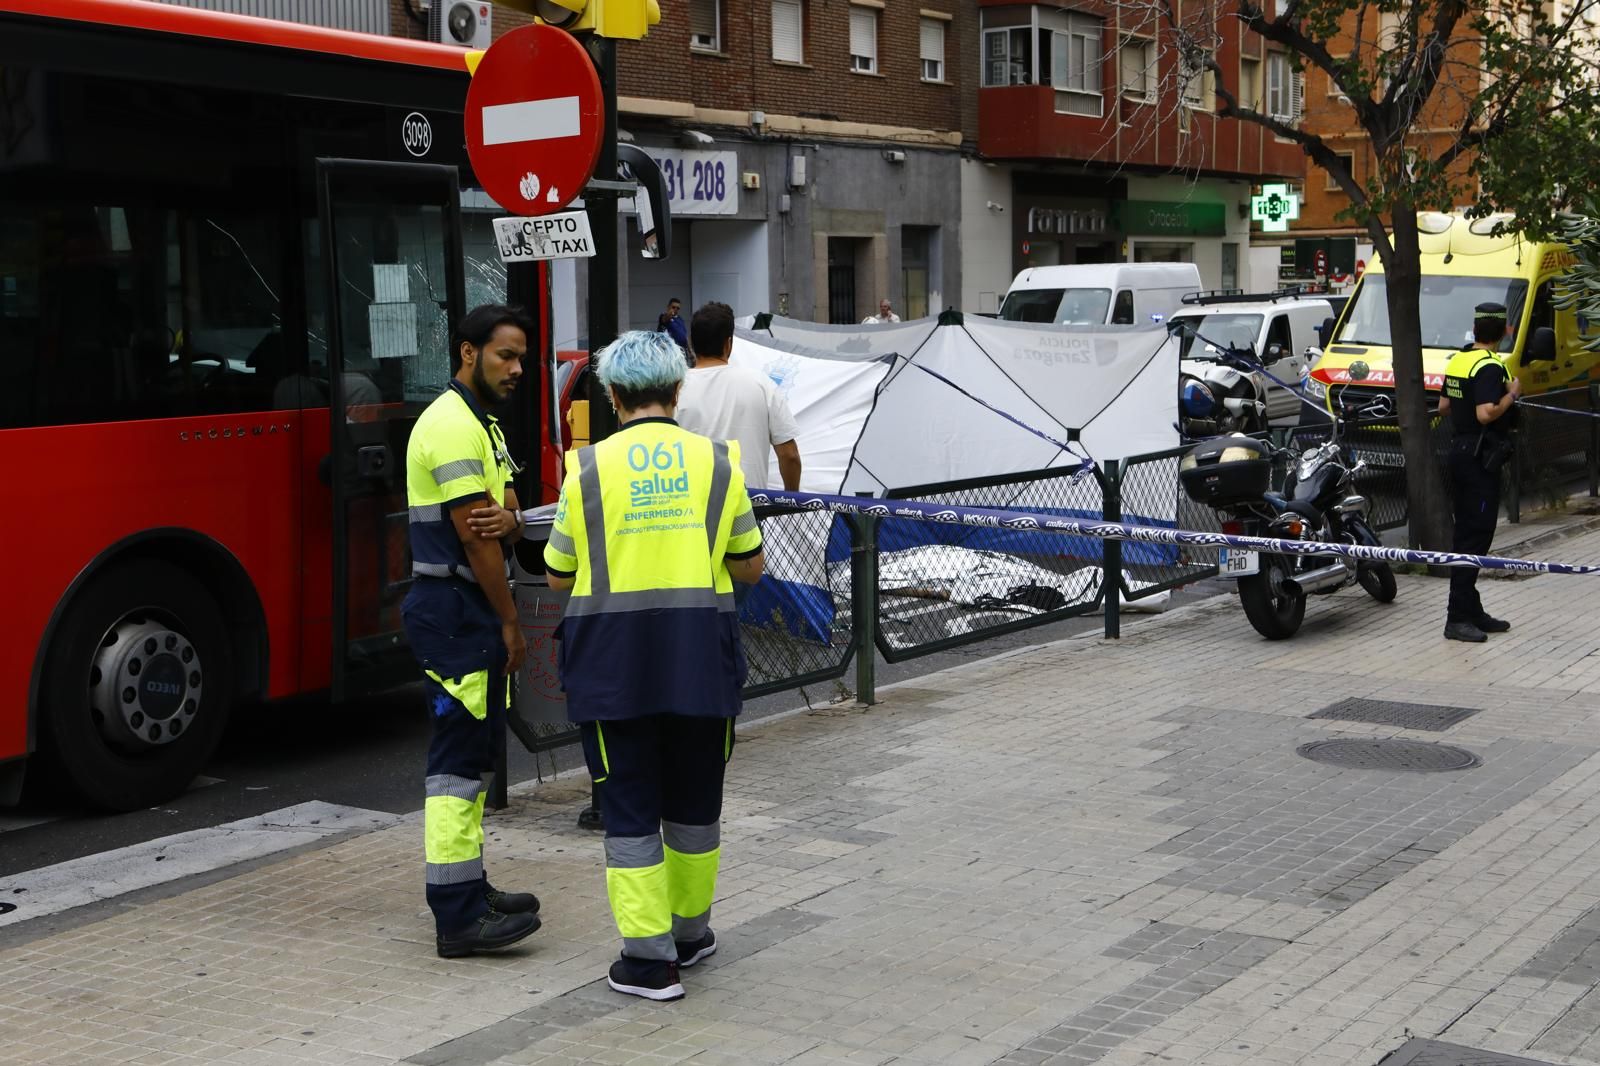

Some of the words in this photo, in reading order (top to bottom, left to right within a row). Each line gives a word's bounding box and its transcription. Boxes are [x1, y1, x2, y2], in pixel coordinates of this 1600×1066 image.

[406, 121, 429, 148] 3098
[693, 160, 725, 202] 208
[1258, 201, 1289, 215] 11:30
[552, 238, 588, 254] TAXI
[628, 442, 685, 472] 061
[630, 471, 689, 496] salud
[1130, 526, 1162, 541] PASAR
[1160, 528, 1178, 542] NO
[1347, 545, 1388, 559] PASAR
[1387, 548, 1408, 561] NO
[1228, 557, 1247, 571] FHD
[147, 681, 180, 695] IVECO
